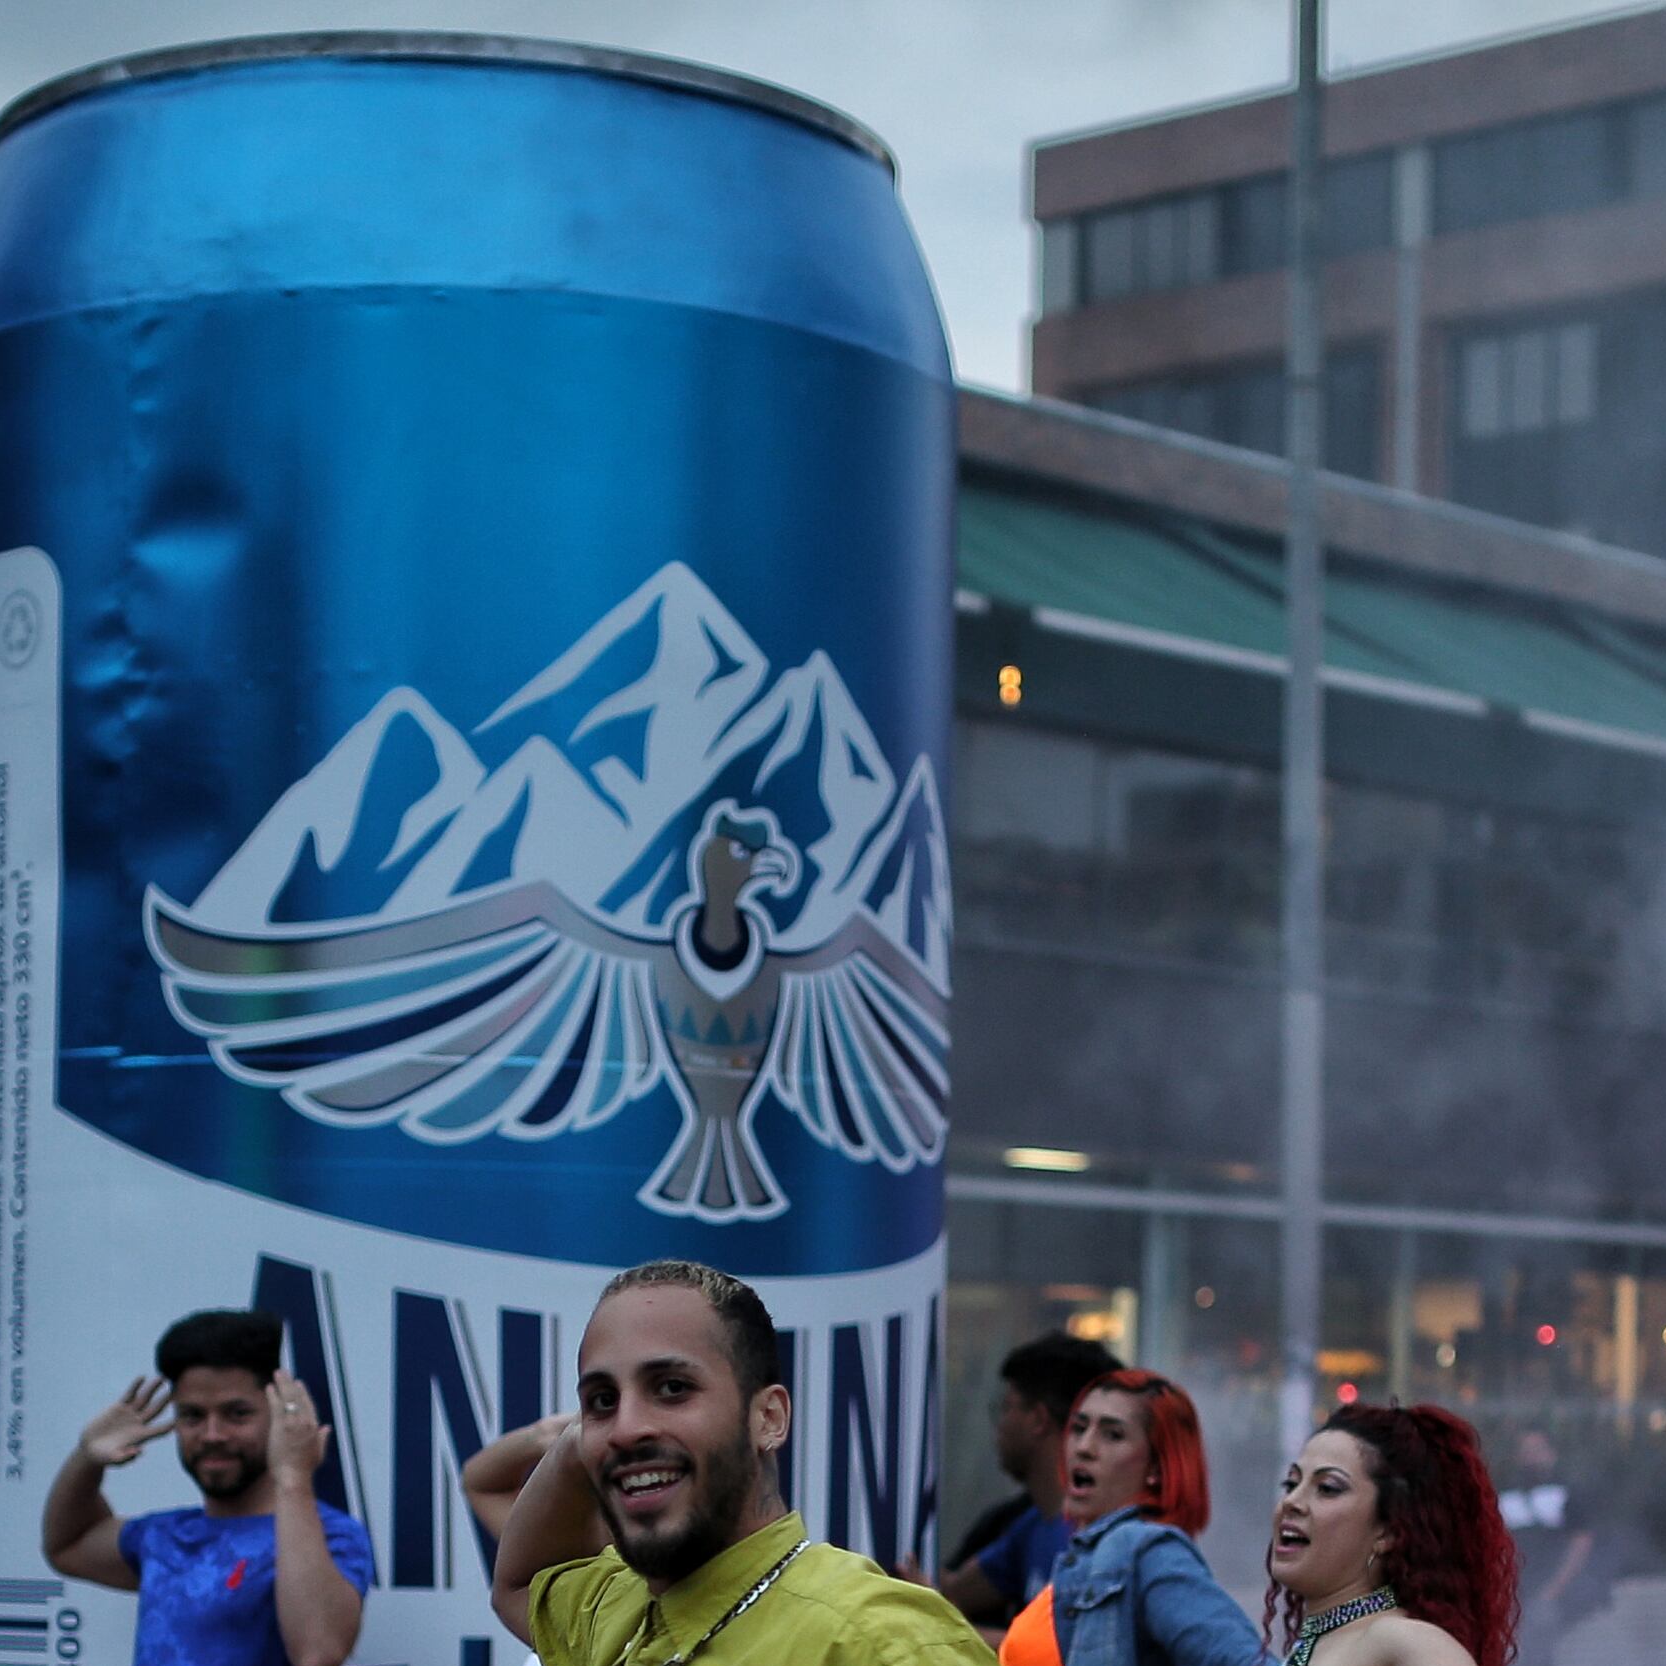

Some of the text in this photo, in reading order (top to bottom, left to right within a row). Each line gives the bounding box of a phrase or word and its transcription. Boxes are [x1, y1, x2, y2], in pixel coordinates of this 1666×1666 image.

[12, 930, 31, 986] 330
[14, 990, 31, 1063] neto
[10, 1064, 30, 1220] Contenido
[8, 1227, 28, 1361] volumen.
[9, 1364, 25, 1406] en
[5, 1408, 25, 1481] 3,4%
